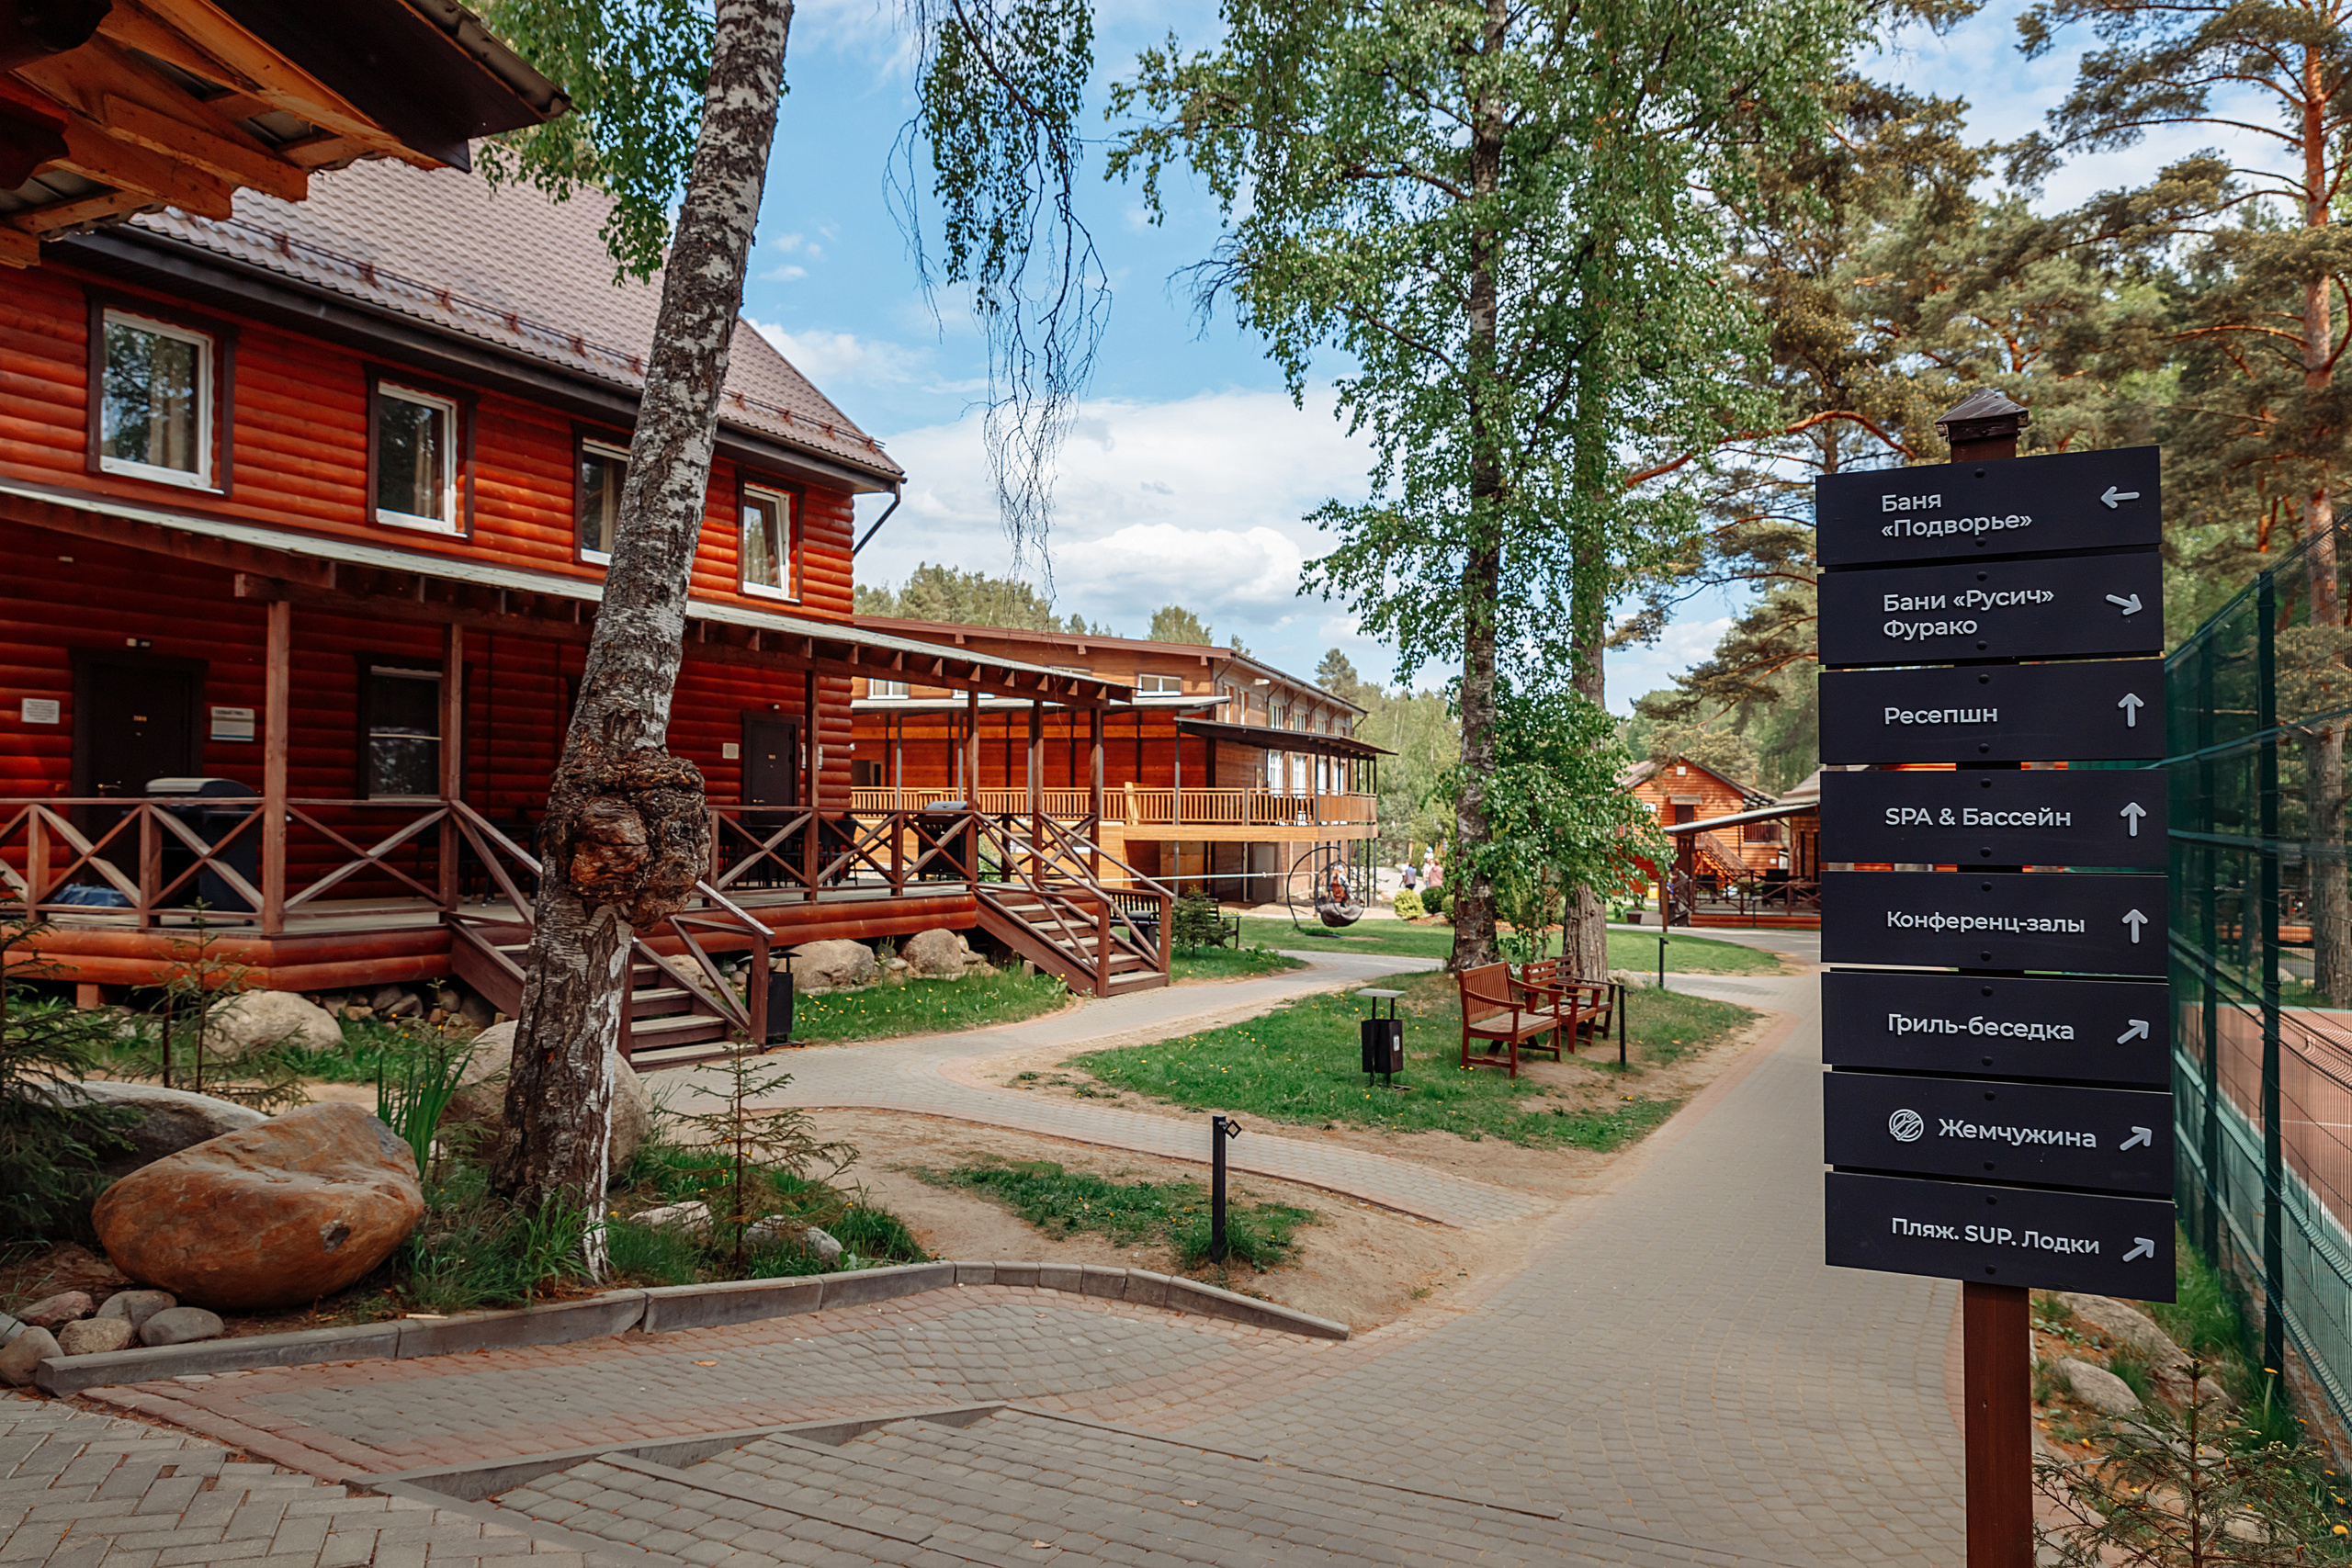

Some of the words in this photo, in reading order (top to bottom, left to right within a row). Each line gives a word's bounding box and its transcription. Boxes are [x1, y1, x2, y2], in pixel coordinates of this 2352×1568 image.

[1882, 493, 1942, 513] Баня
[1881, 514, 2033, 538] «Подворье»
[1883, 593, 1946, 612] Бани
[1952, 589, 2055, 611] «Русич»
[1883, 619, 1978, 641] Фурако
[1884, 706, 1998, 725] Ресепшн
[1884, 807, 1934, 826] SPA
[1939, 807, 1956, 826] &
[1962, 807, 2071, 827] Бассейн
[1887, 910, 2086, 933] Конференц-залы
[1888, 1013, 2075, 1042] Гриль-беседка
[1938, 1118, 2097, 1148] Жемчужина
[1892, 1217, 1960, 1240] Пляж.
[1964, 1224, 2017, 1247] SUP.
[2021, 1230, 2099, 1255] Лодки
